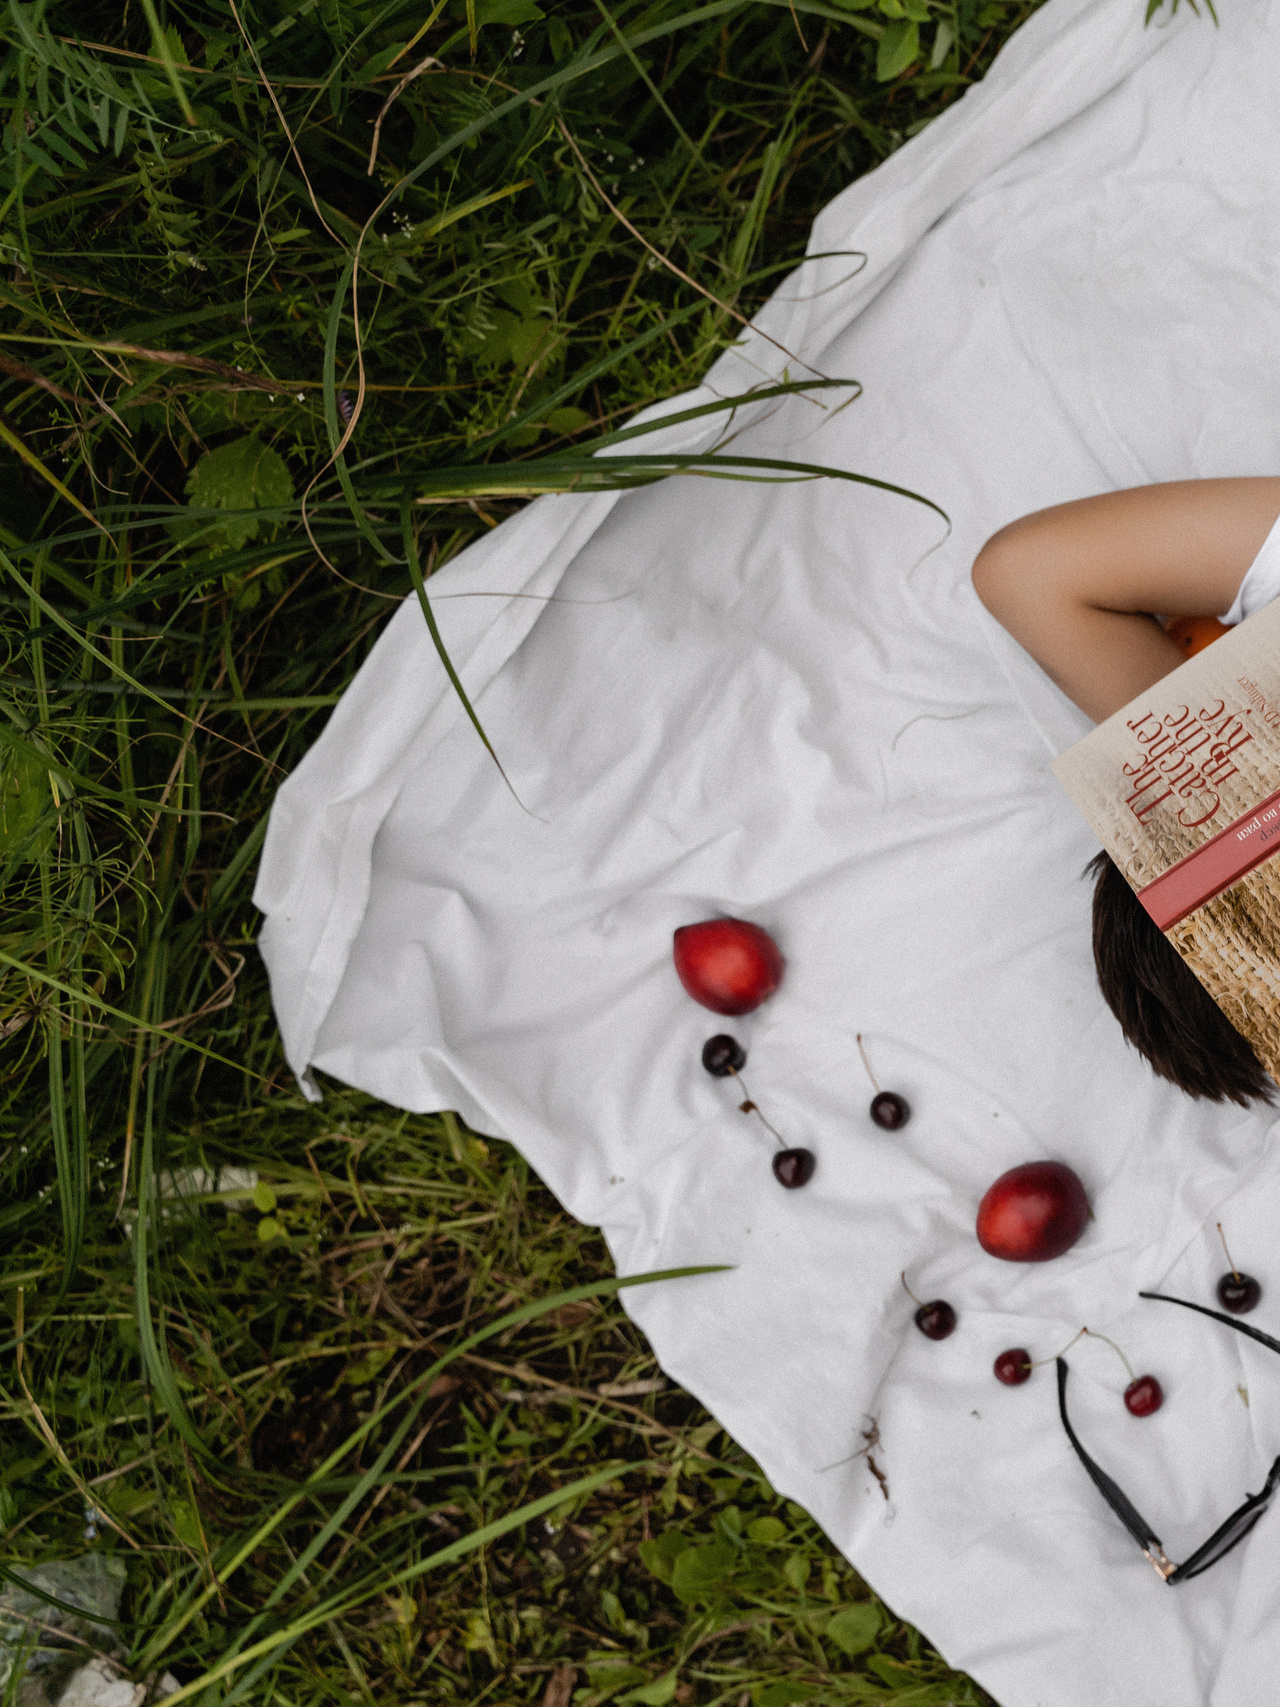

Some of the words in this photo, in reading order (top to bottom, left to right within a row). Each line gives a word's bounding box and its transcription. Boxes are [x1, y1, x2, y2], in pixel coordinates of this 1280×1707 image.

[1236, 677, 1270, 714] Salinger
[1164, 704, 1209, 756] the
[1199, 699, 1253, 765] Rye
[1123, 755, 1175, 826] The
[1127, 711, 1220, 827] Catcher
[1200, 748, 1240, 788] in
[1236, 817, 1261, 841] ржи
[1263, 807, 1278, 823] во
